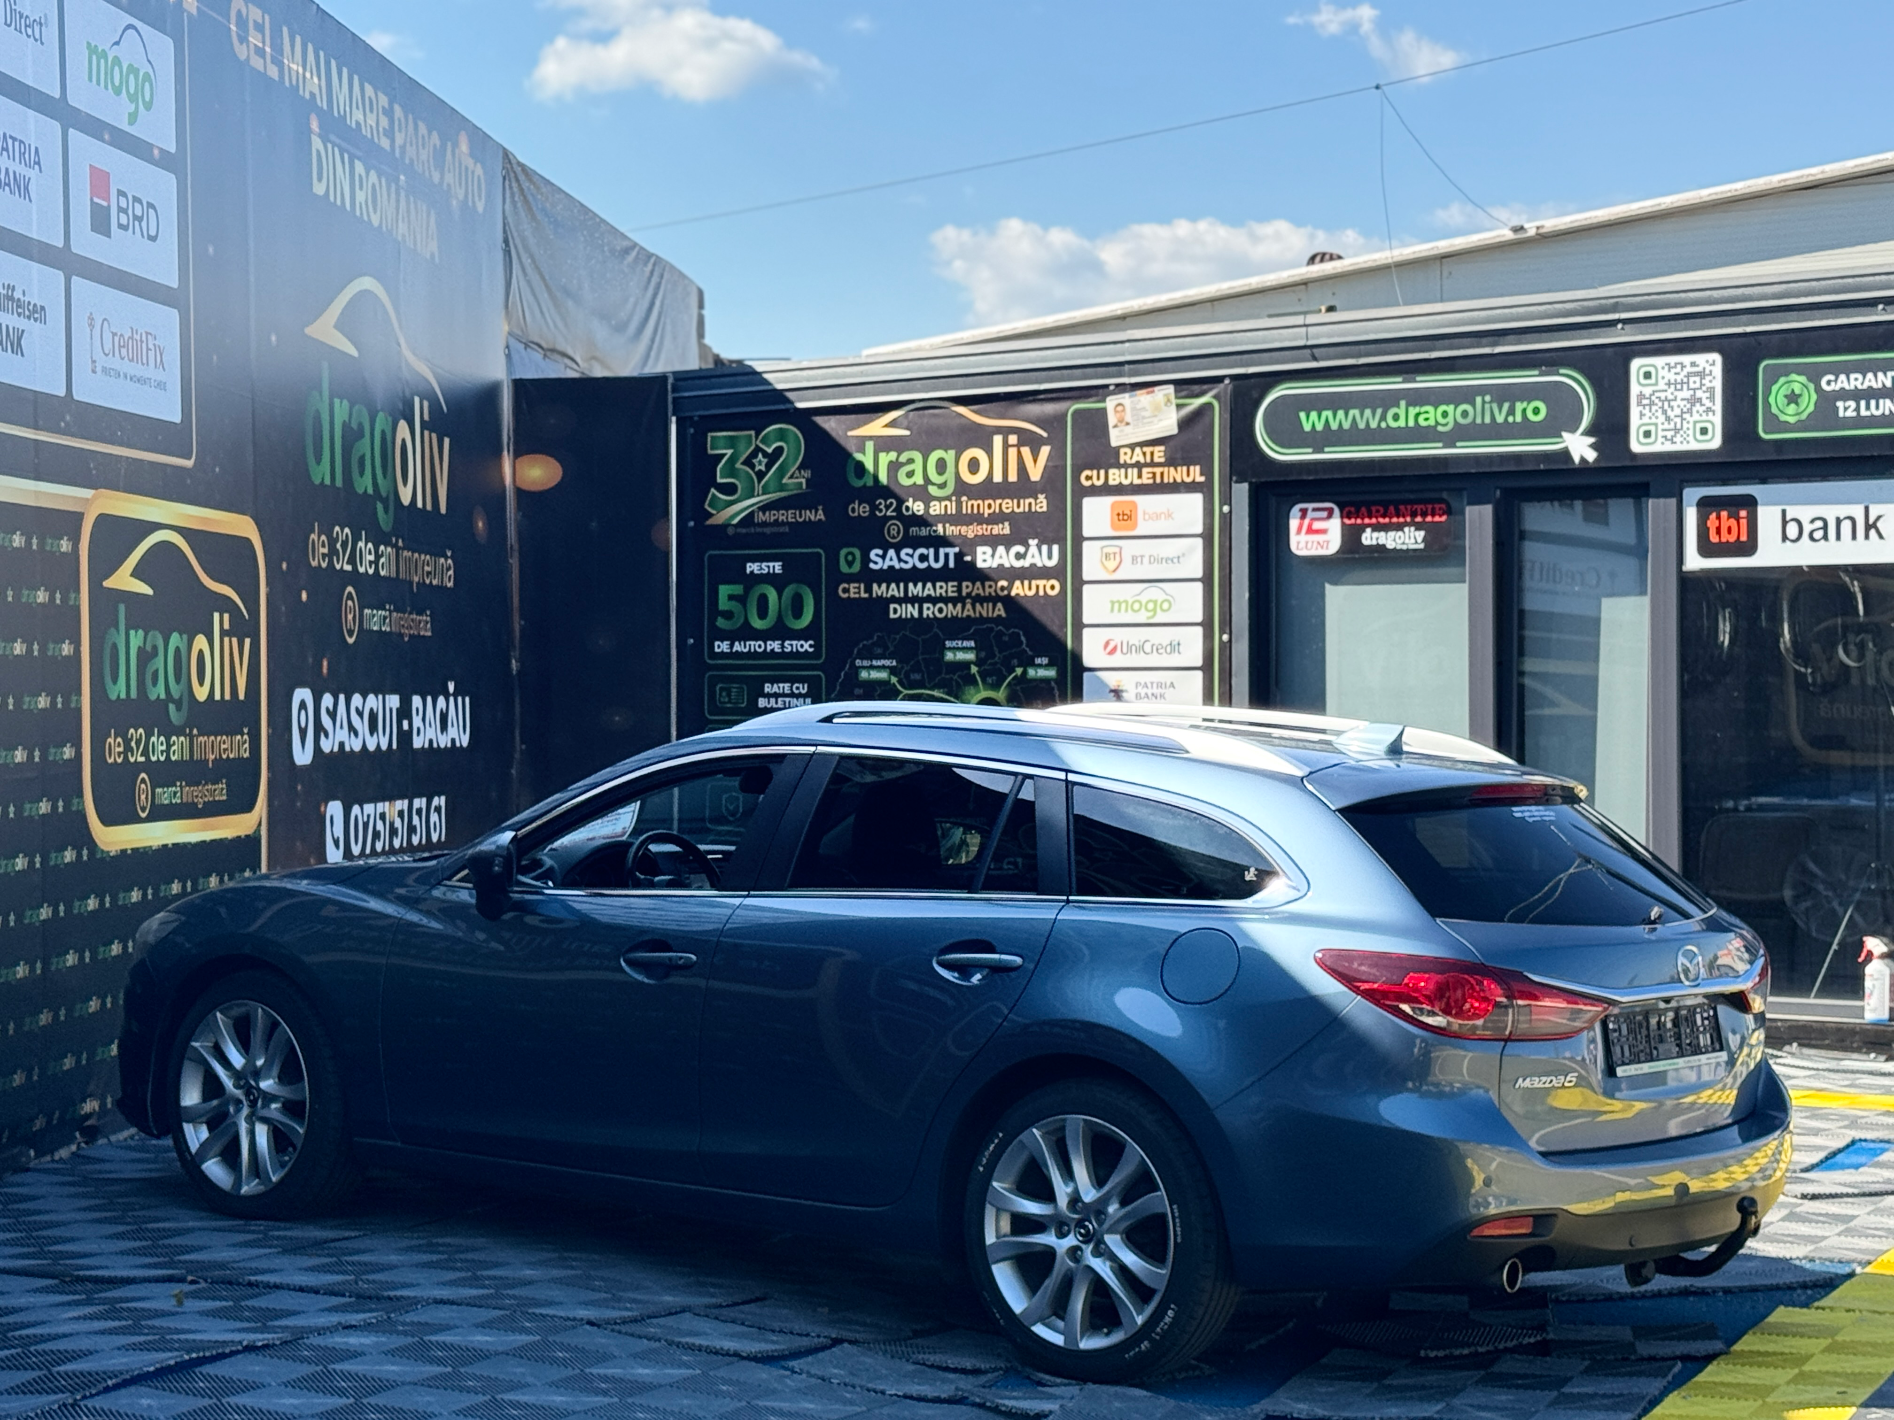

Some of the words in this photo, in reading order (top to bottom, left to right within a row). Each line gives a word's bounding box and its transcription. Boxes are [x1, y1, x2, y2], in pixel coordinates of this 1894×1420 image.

[4, 0, 45, 46] Direct
[86, 40, 154, 126] mogo
[230, 0, 279, 81] CEL
[282, 25, 327, 110] MAI
[330, 57, 391, 152] MARE
[393, 103, 441, 185] PARC
[443, 141, 486, 214] AUTO
[0, 131, 43, 174] ATRIA
[310, 132, 351, 211] DIN
[117, 188, 159, 242] BRD
[100, 318, 166, 372] CreditFix
[1820, 371, 1894, 391] GARAN
[1298, 394, 1547, 432] www.dragoliv.ro
[1835, 400, 1857, 417] 12
[305, 361, 450, 533] dragoliv
[1119, 446, 1165, 464] RATE
[704, 424, 805, 515] 32
[846, 434, 1051, 497] dragoliv
[1080, 469, 1105, 487] CU
[1108, 465, 1206, 485] BULETINUL
[754, 505, 826, 523] ÎMPREUNĂ
[849, 500, 870, 516] de
[875, 499, 897, 516] 32
[902, 498, 924, 515] de
[929, 496, 956, 515] ani
[961, 494, 1047, 517] împreună
[1116, 510, 1133, 522] tbi
[1143, 508, 1174, 522] bank
[909, 523, 943, 537] marcă
[945, 522, 1010, 538] înregistrată
[1295, 507, 1334, 535] 12
[1342, 503, 1448, 524] GARANTIE
[1706, 510, 1748, 543] tbi
[1780, 505, 1886, 544] bank
[1296, 540, 1331, 551] LUNI
[1361, 526, 1425, 549] dragoliv
[308, 522, 329, 569] de
[332, 525, 352, 571] 32
[356, 530, 375, 575] de
[379, 537, 396, 578] ani
[869, 547, 959, 570] SASCUT
[976, 538, 1059, 568] BACĂU
[1105, 552, 1118, 561] BT
[1131, 554, 1145, 565] BT
[1148, 553, 1181, 565] Direct
[746, 562, 783, 574] PESTE
[838, 583, 868, 598] CEL
[872, 582, 904, 598] MAI
[908, 581, 958, 597] MARE
[962, 580, 1008, 596] PARC
[1011, 579, 1061, 596] AUTO
[715, 583, 814, 630] 500
[889, 603, 919, 619] DIN
[923, 600, 1006, 618] ROMÂNIA
[1109, 598, 1172, 620] mogo
[714, 641, 731, 652] DE
[733, 641, 764, 652] AUTO
[767, 641, 782, 652] PE
[784, 640, 815, 652] STOC
[945, 640, 975, 648] SUCEAVA
[1120, 639, 1182, 655] UniCredit
[103, 603, 250, 726] dragoliv
[764, 683, 791, 694] RATE
[793, 683, 808, 694] CU
[1135, 681, 1176, 690] PATRIA
[1135, 692, 1167, 701] BANK
[320, 692, 400, 753] SASCUT
[412, 681, 470, 749] BACĂU
[105, 728, 124, 764] de
[128, 728, 145, 763] 32
[149, 728, 166, 761] de
[170, 728, 189, 761] ani
[193, 727, 250, 768] împreună
[350, 801, 389, 856] 0751
[393, 799, 409, 849] 51
[412, 797, 426, 846] 51
[430, 795, 446, 843] 61
